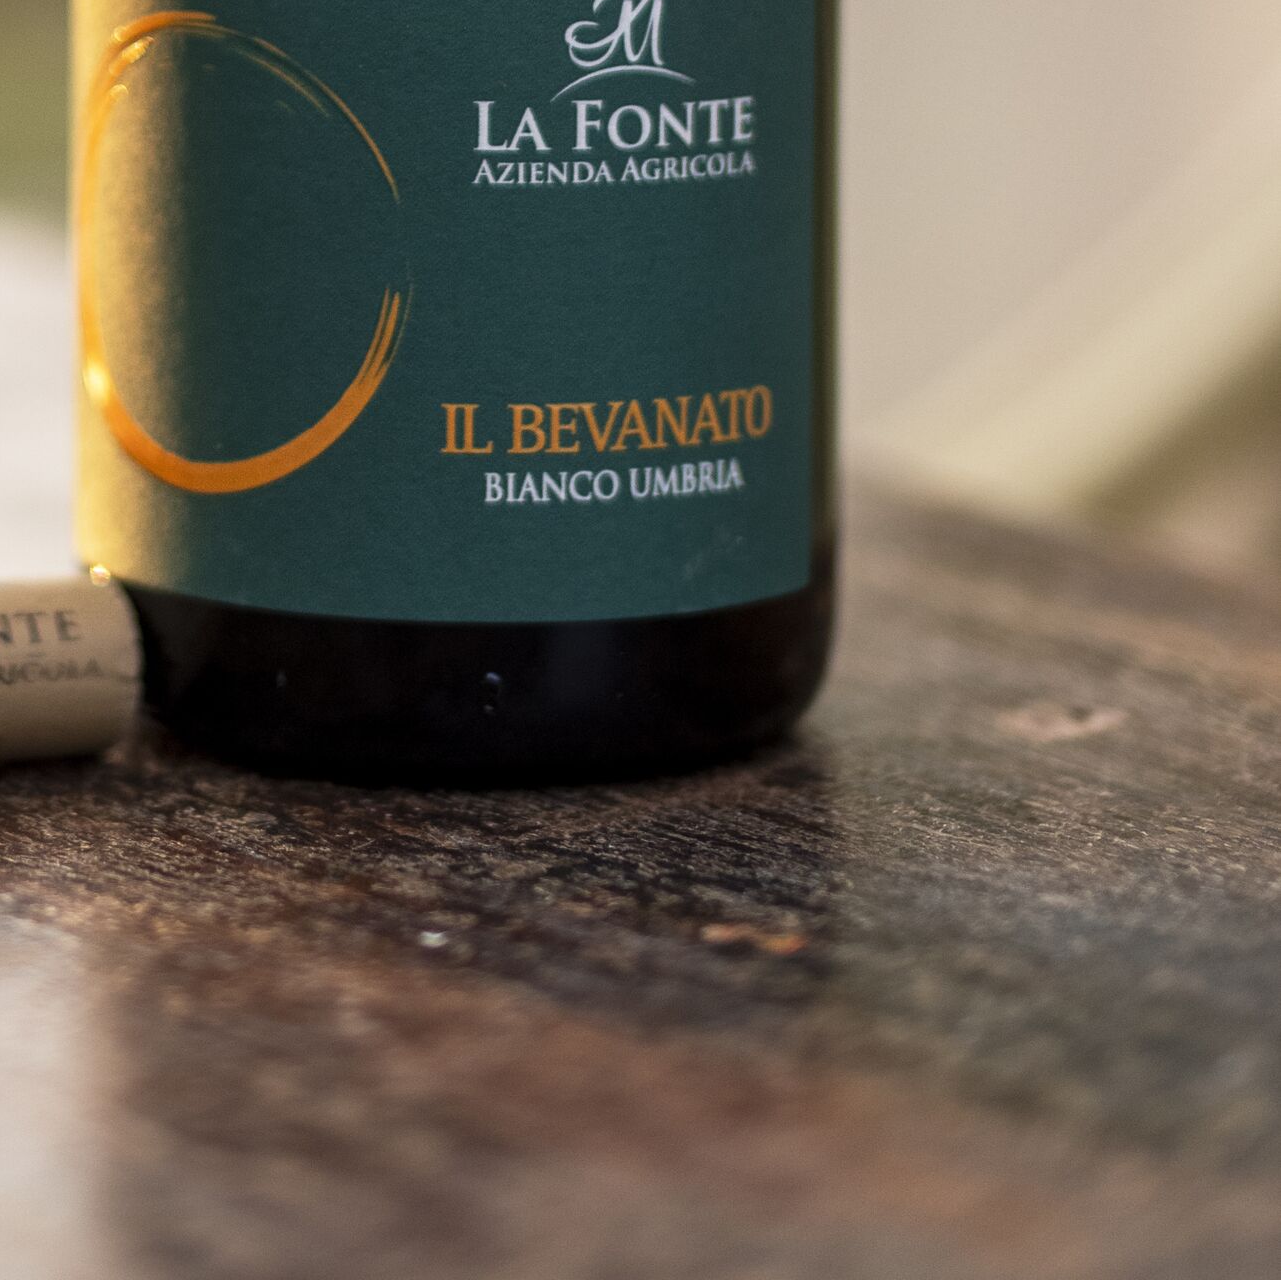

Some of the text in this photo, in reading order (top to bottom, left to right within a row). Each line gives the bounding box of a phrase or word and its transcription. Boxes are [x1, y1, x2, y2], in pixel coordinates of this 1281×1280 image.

[472, 95, 755, 152] LA FONTE
[471, 151, 756, 186] AZIENDA AGRICOLA
[440, 384, 773, 454] IL BEVANATO
[484, 457, 745, 503] BIANCO UMBRIA
